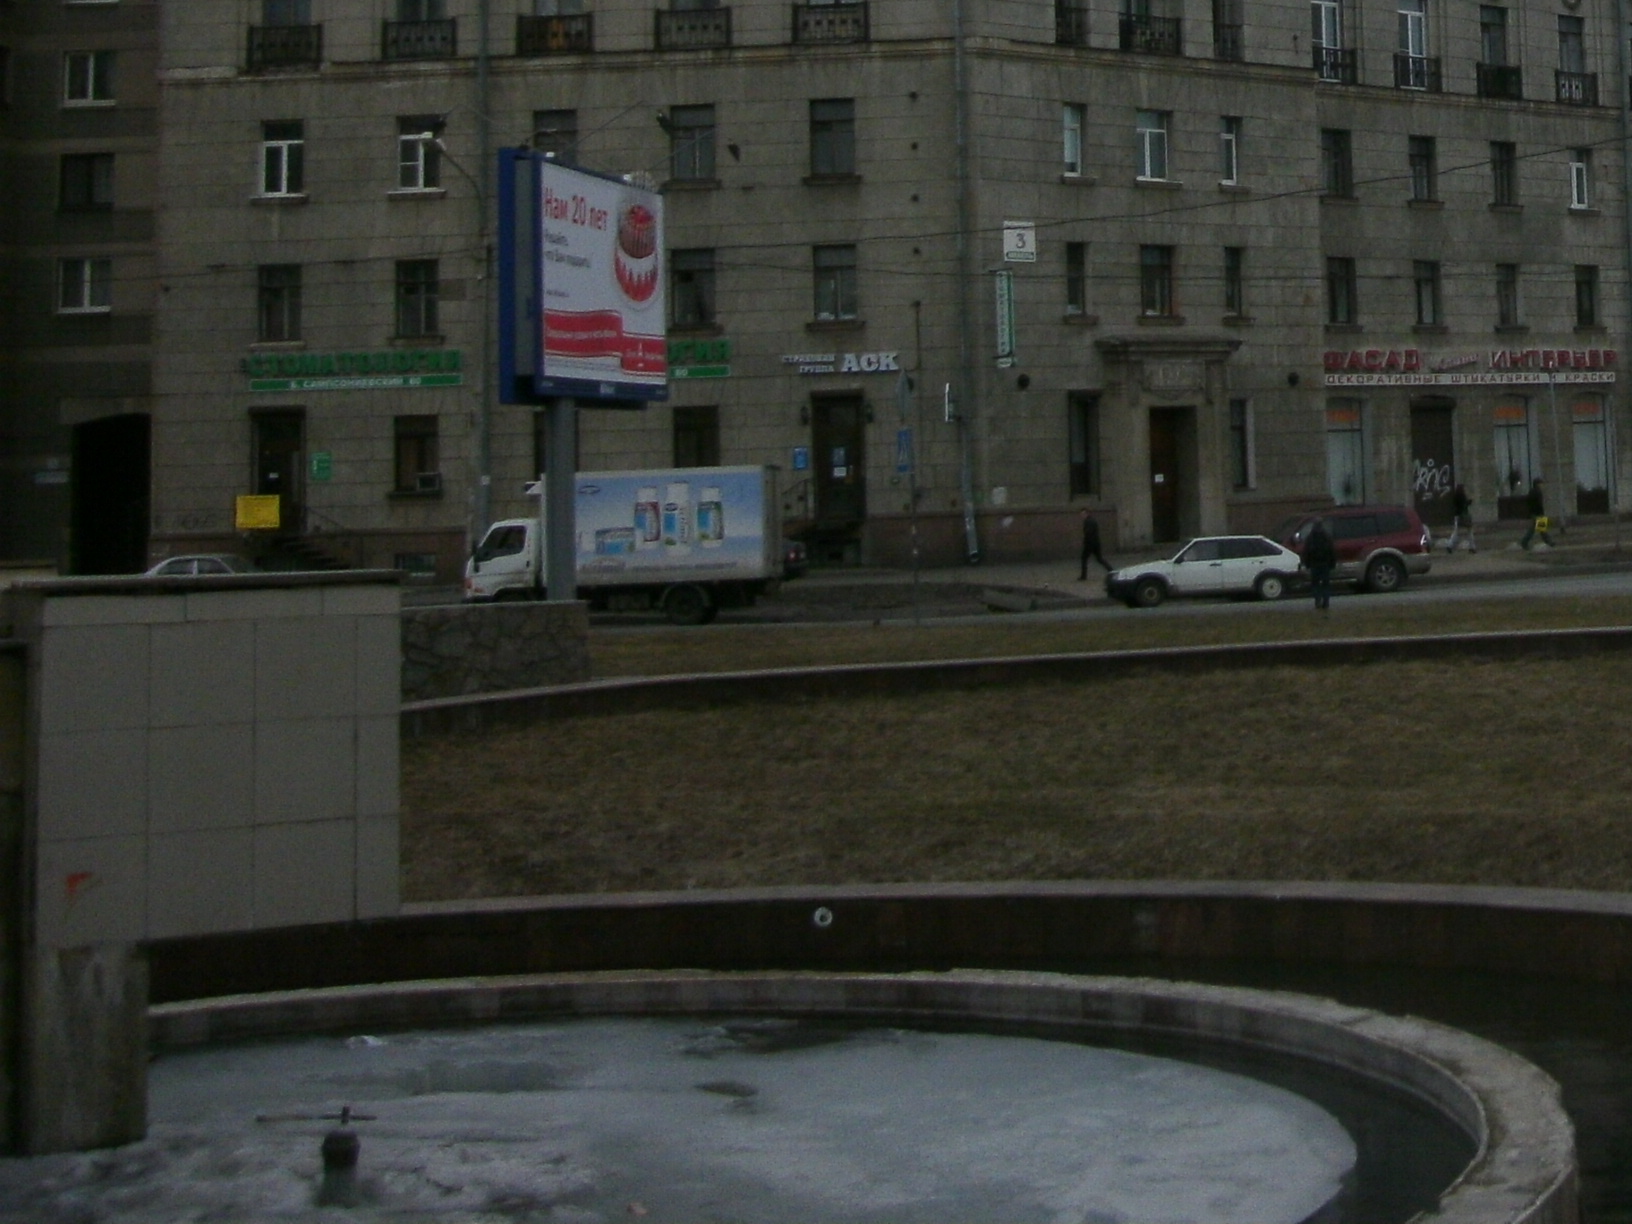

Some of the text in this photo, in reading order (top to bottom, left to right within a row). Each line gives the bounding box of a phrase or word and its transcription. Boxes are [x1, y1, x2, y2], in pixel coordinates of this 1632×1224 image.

[571, 195, 586, 227] 20
[589, 206, 608, 232] лет
[1015, 232, 1026, 249] 3
[246, 349, 461, 376] СТОМАТОЛОГИЯ
[841, 351, 899, 372] АСК
[1324, 349, 1420, 371] ФАСАД
[1489, 349, 1617, 369] ИНТЕРЬЕР
[1327, 375, 1441, 385] ДЕКОРАТИВНЫЕ
[1451, 374, 1540, 384] ШТУКАТУРКИ
[1565, 372, 1615, 382] КРАСКИ
